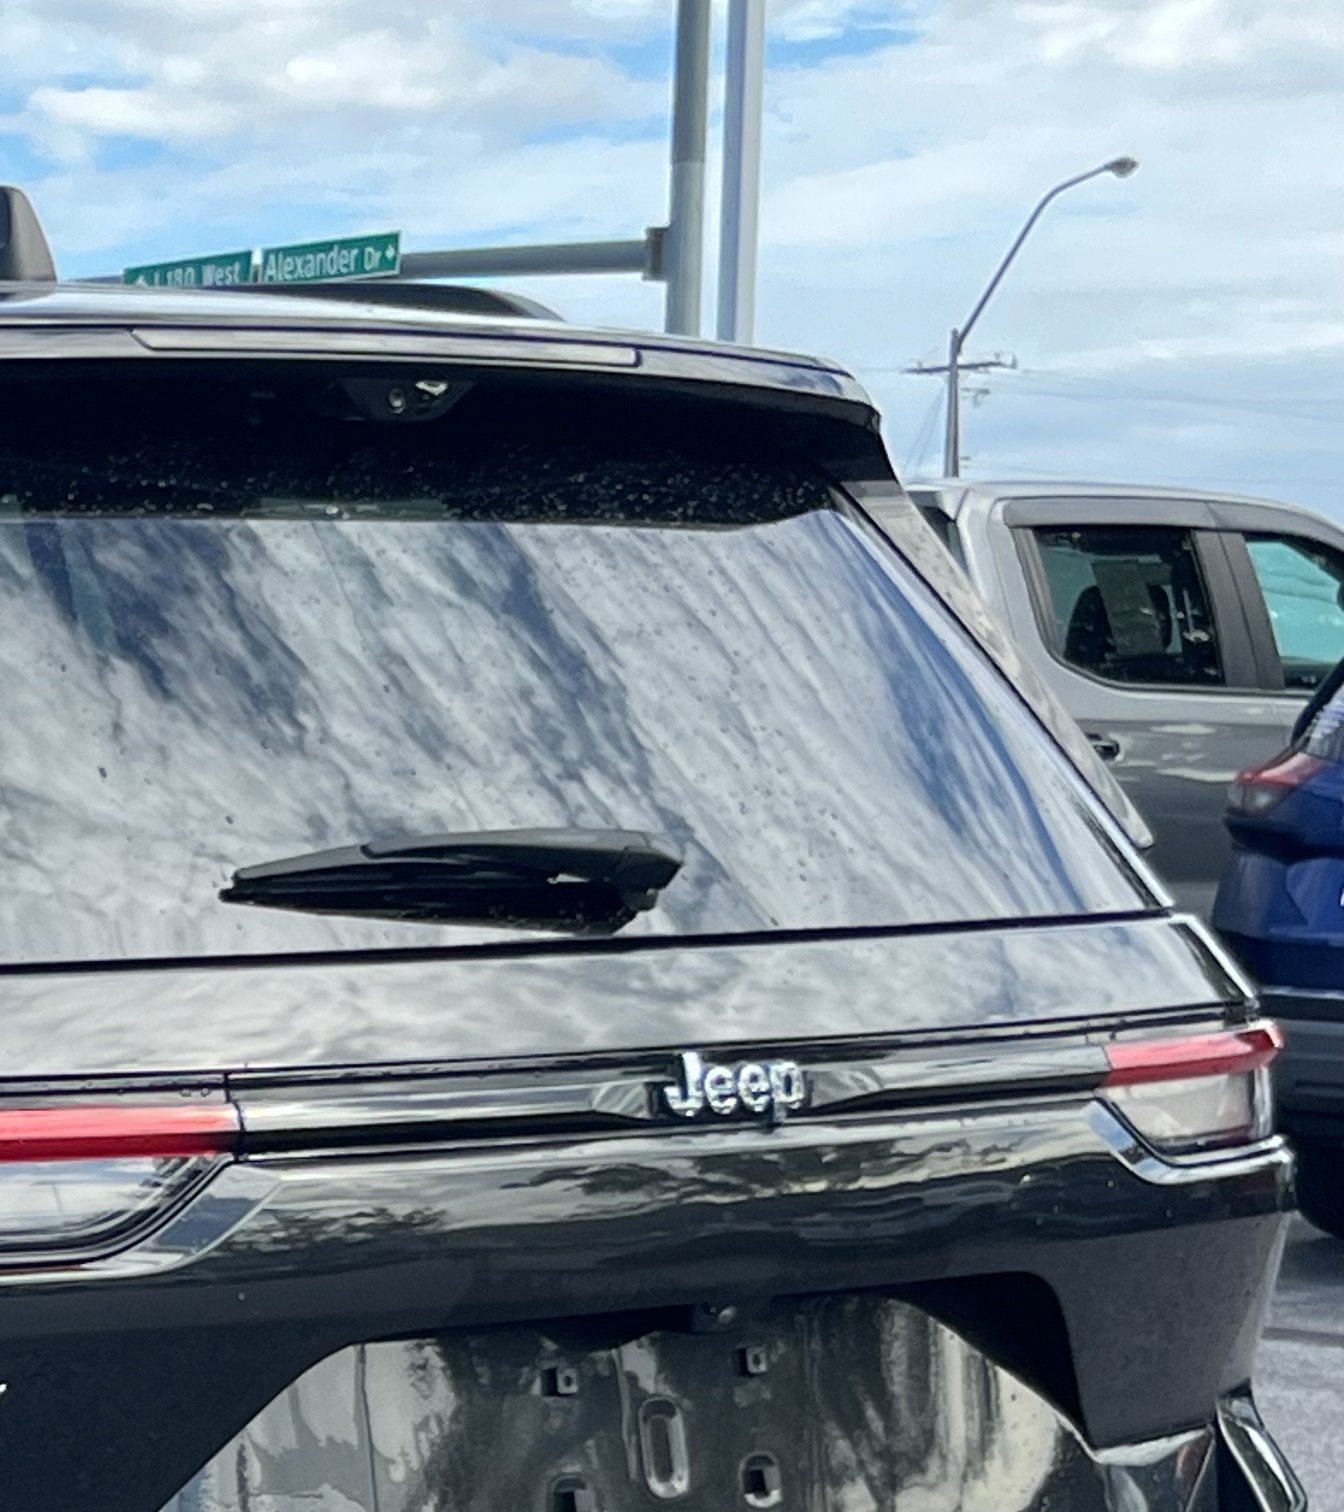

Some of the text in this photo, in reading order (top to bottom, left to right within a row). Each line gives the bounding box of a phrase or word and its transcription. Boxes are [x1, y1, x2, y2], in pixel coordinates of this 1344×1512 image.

[201, 261, 241, 287] West
[263, 244, 382, 283] Alexander Dr
[663, 1051, 805, 1124] Jeep
